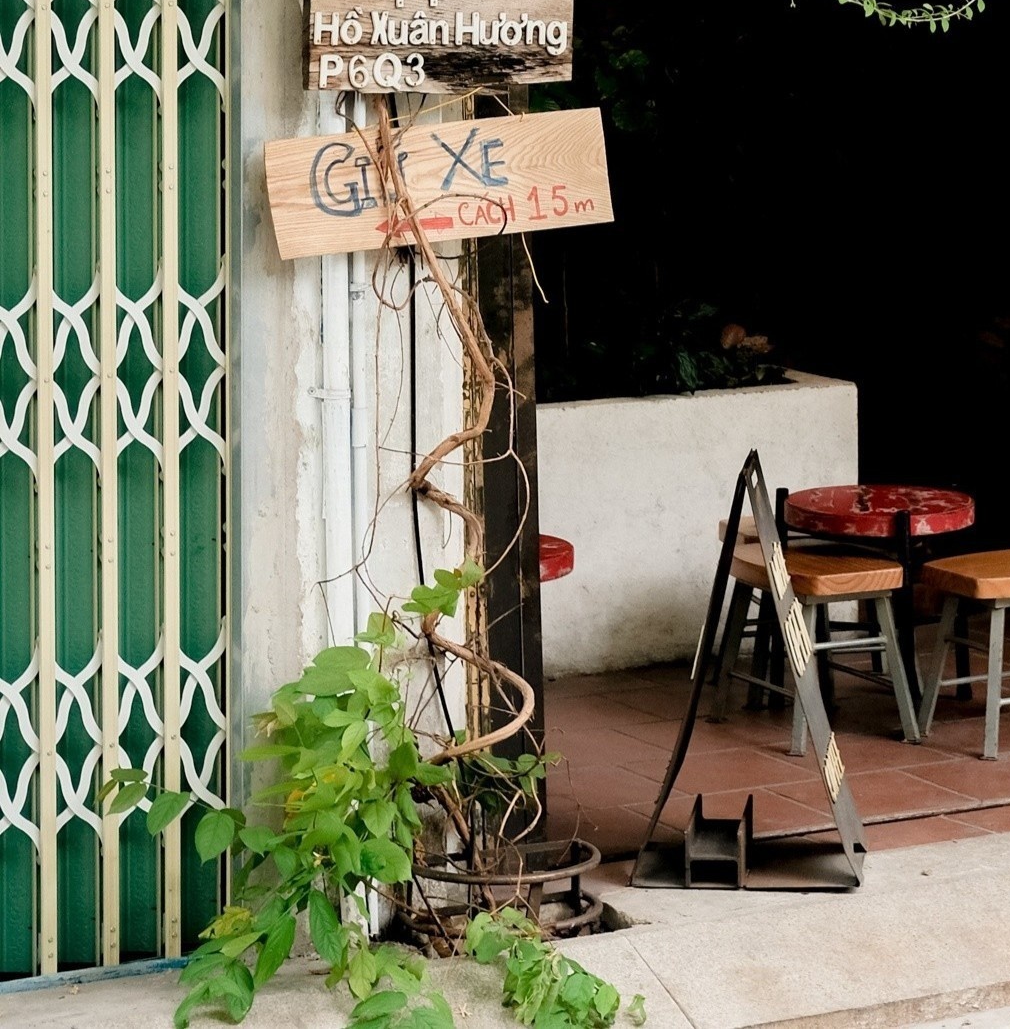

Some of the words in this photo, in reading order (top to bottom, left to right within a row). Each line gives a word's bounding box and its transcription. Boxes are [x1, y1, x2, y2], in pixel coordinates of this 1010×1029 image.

[312, 6, 364, 46] Hồ
[370, 10, 450, 46] Xuân
[454, 11, 568, 56] Hương
[318, 52, 426, 91] P6Q3
[430, 127, 509, 192] XE
